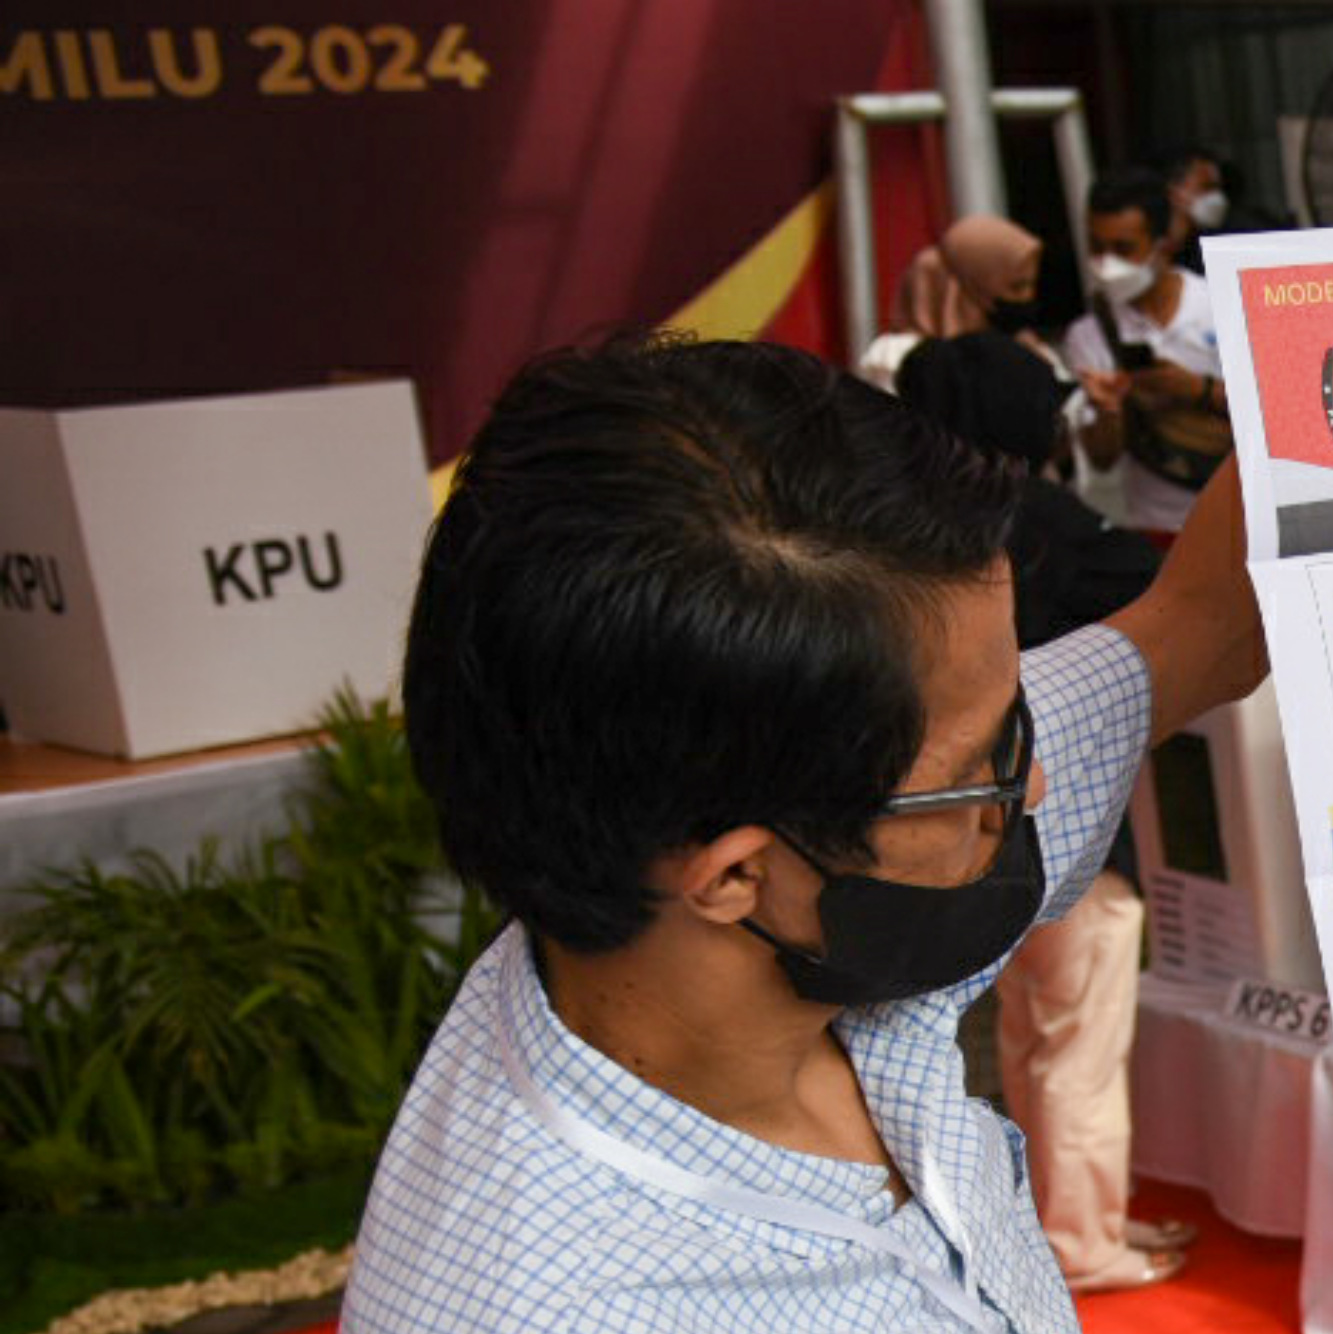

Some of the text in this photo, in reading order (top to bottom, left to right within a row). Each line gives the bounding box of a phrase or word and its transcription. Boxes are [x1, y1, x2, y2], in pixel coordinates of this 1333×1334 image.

[248, 25, 488, 94] 2024
[0, 552, 64, 615] KPU
[203, 532, 343, 606] KPU
[1234, 983, 1303, 1032] KPPS
